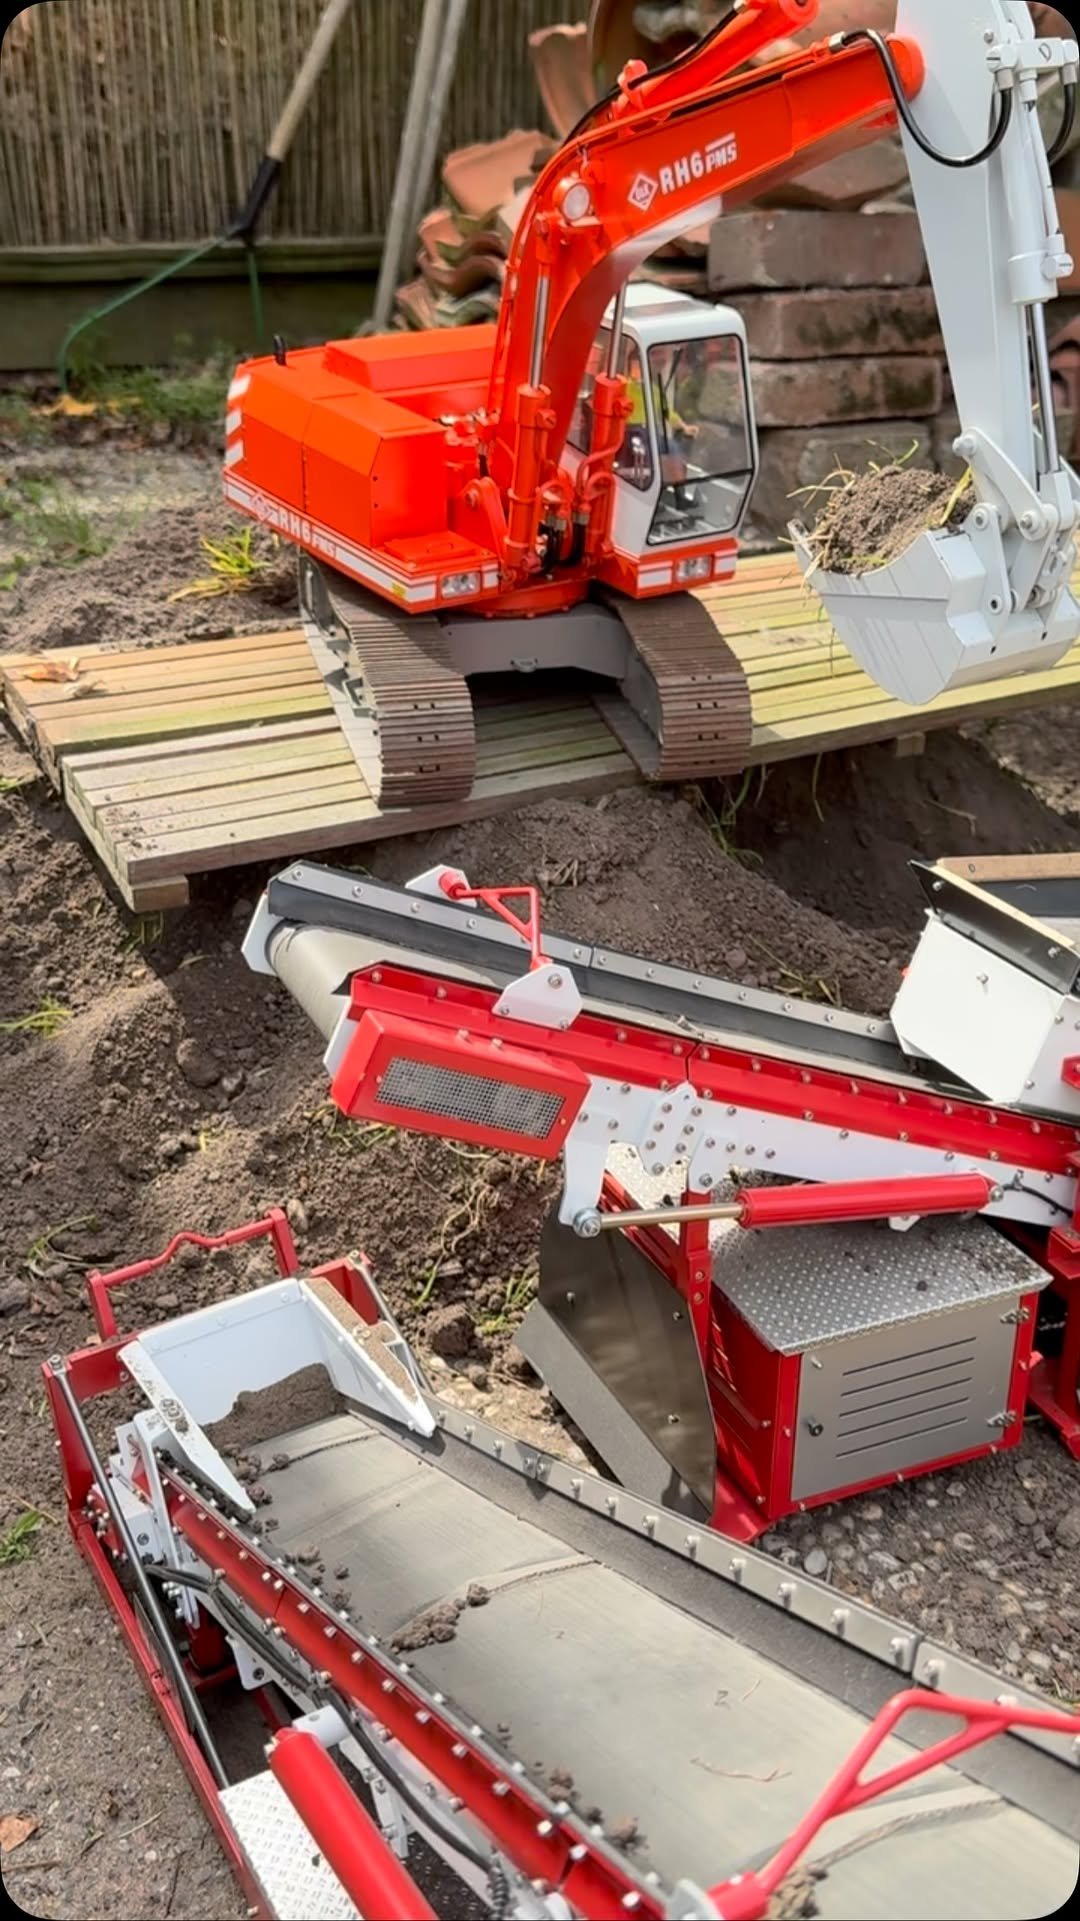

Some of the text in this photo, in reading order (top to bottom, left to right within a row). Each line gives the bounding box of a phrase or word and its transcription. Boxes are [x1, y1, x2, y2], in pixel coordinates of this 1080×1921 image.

[659, 151, 704, 195] RH6
[705, 141, 737, 173] PMS
[279, 506, 311, 544] RH6
